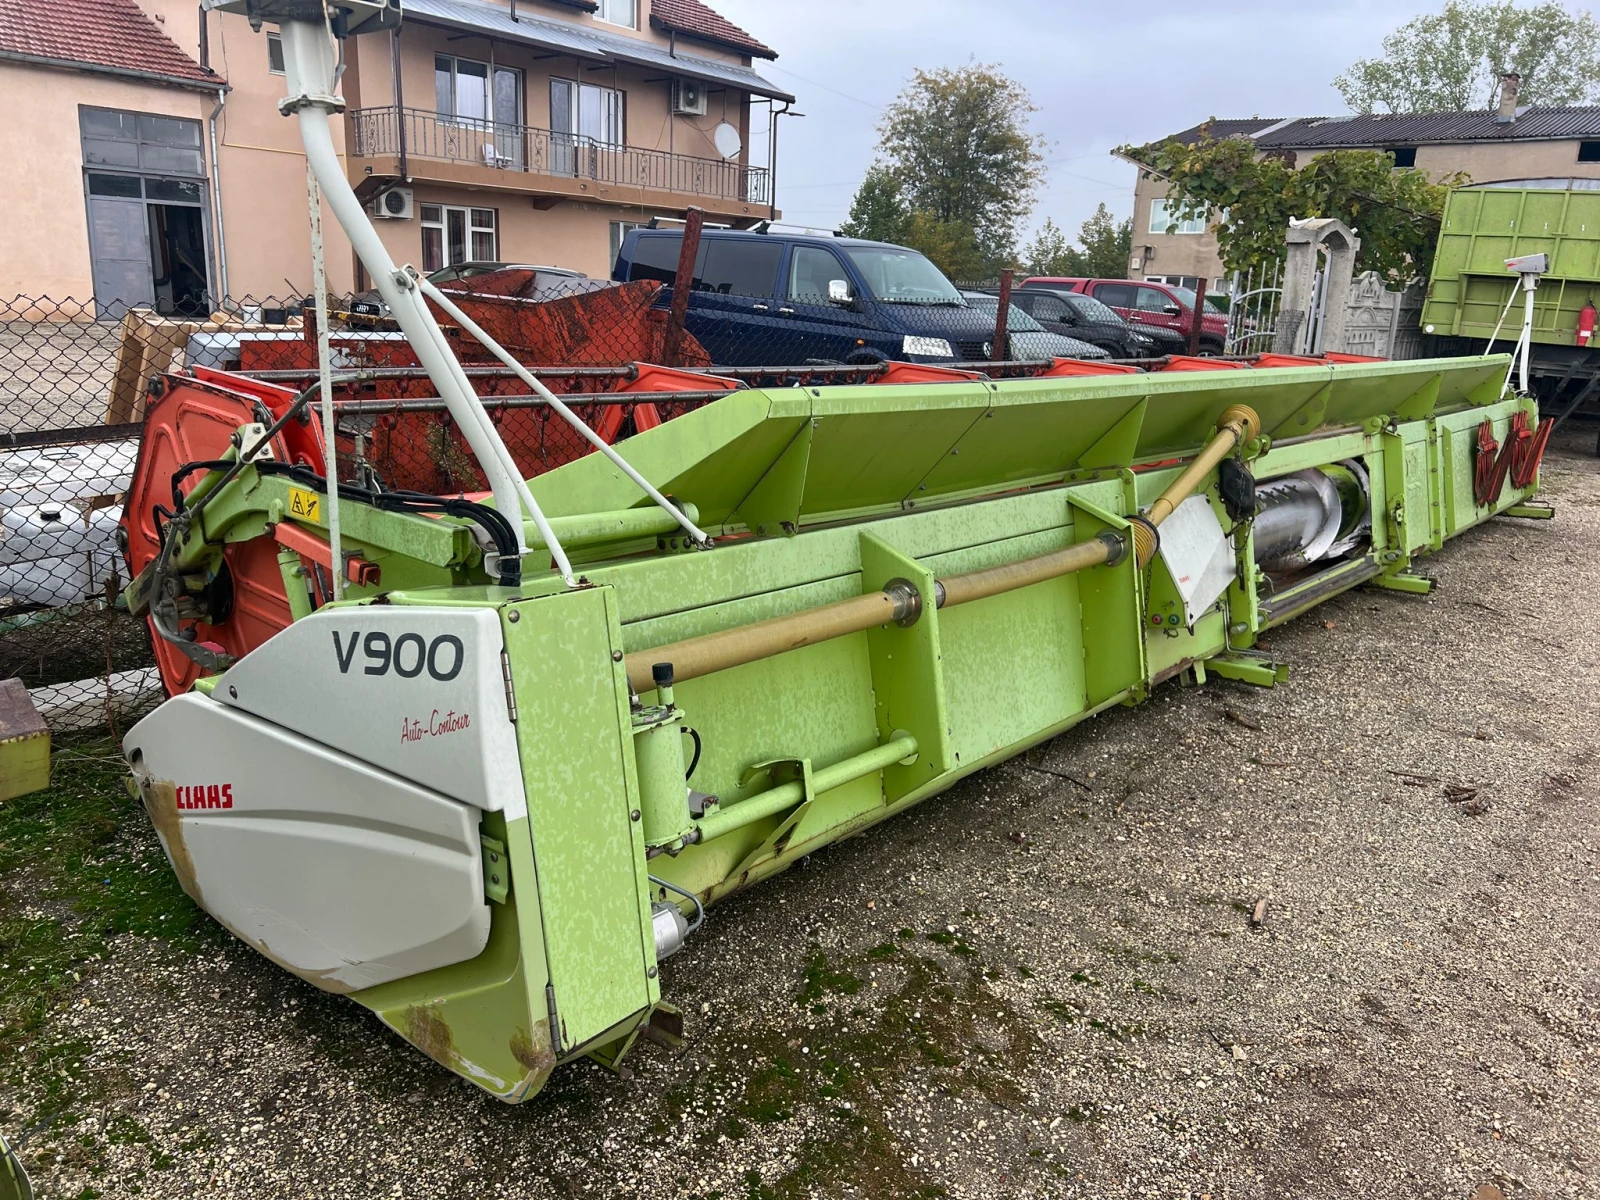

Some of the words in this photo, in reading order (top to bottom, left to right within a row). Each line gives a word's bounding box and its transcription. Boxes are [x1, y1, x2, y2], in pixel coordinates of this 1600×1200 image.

[332, 631, 464, 681] V900
[401, 709, 470, 744] Auto-Contour
[176, 783, 233, 809] CLAAS
